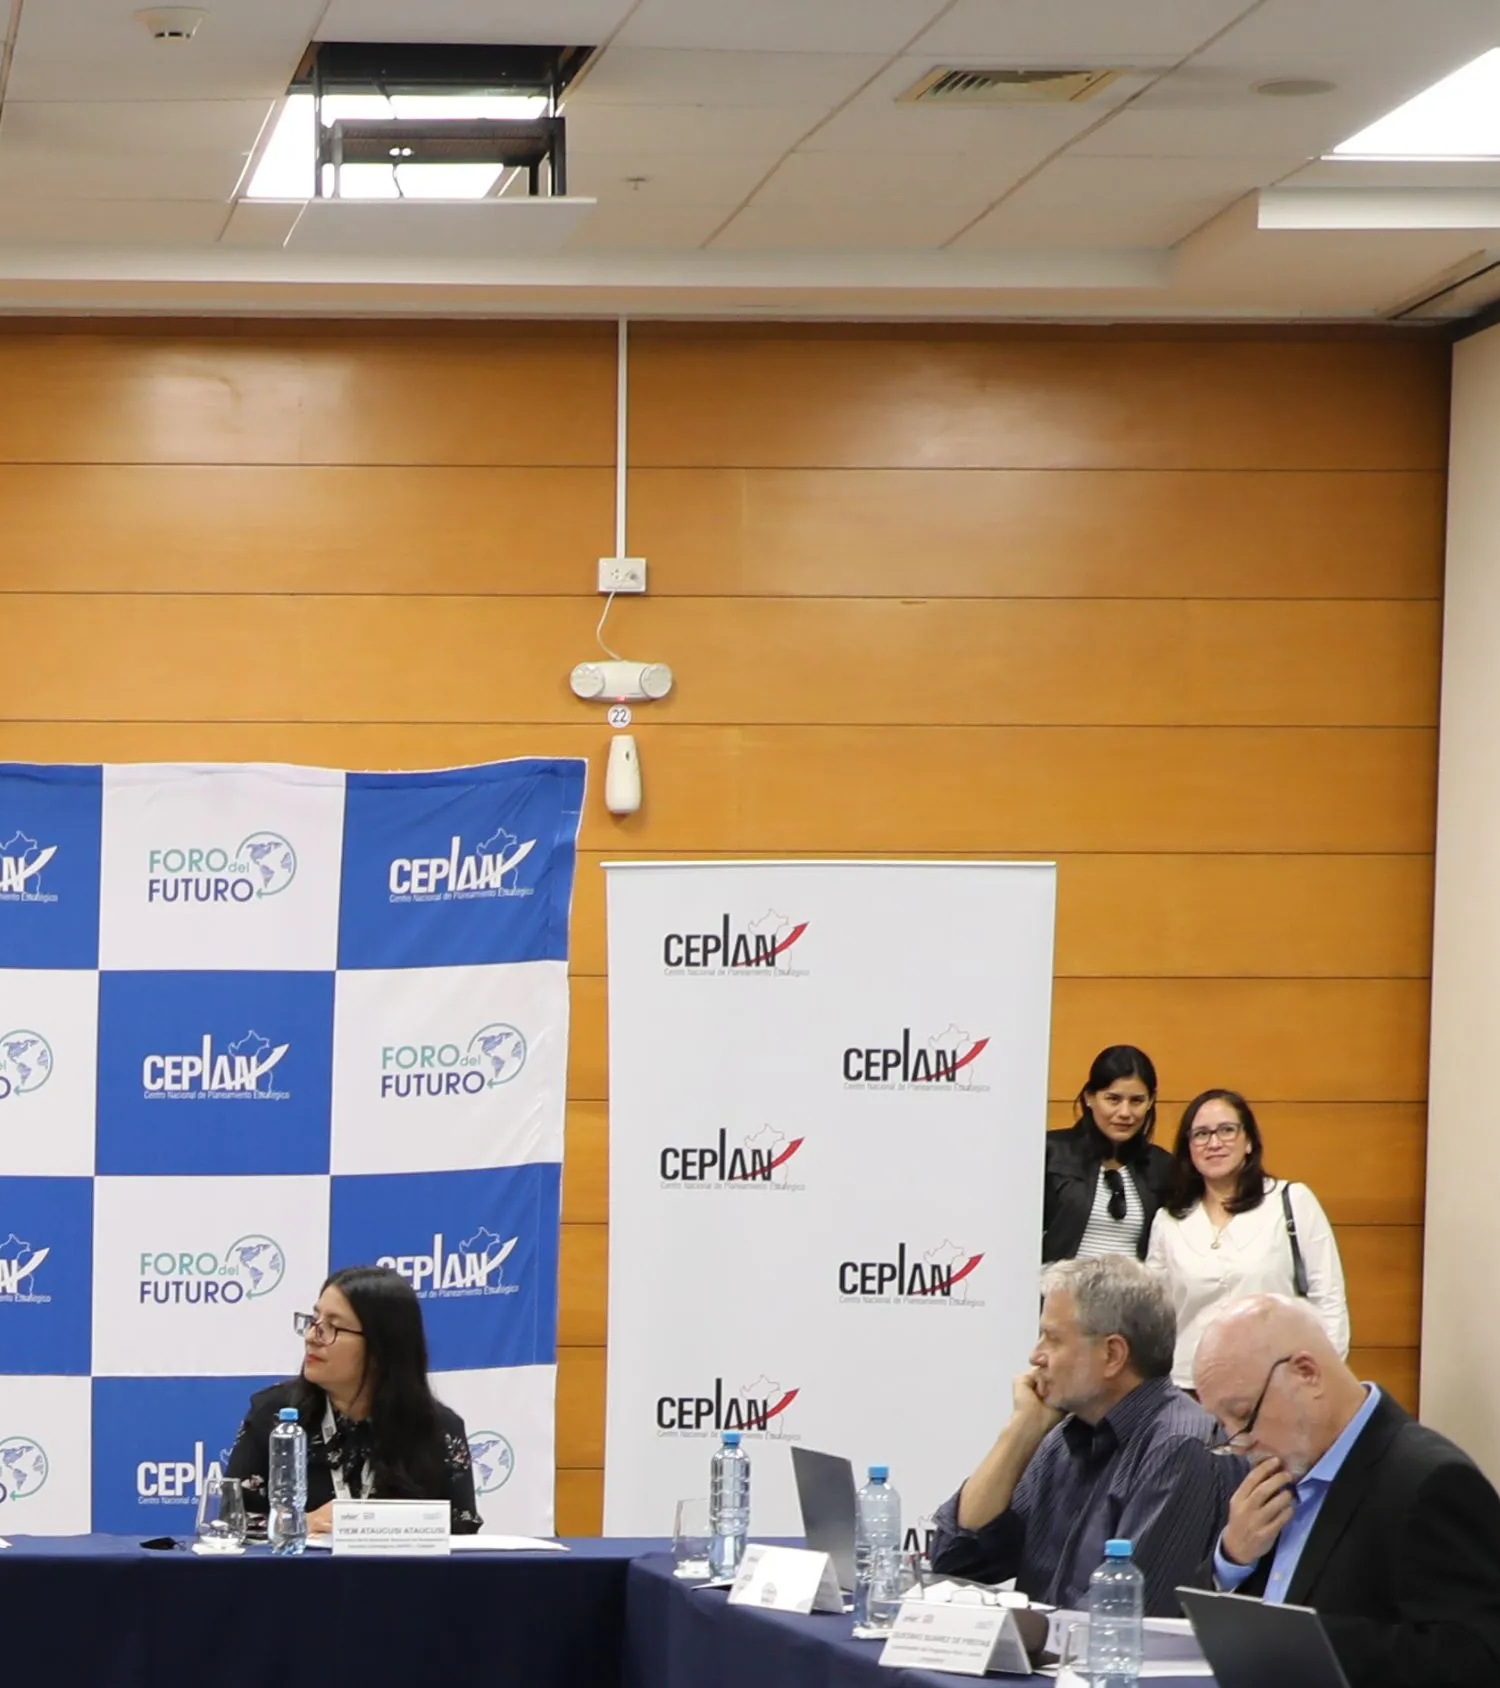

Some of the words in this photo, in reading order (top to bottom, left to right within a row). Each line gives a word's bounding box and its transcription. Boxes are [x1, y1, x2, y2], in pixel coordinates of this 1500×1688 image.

[612, 710, 627, 723] 22
[149, 848, 228, 874] FORO
[228, 861, 250, 873] del
[389, 836, 504, 894] CEPLAN
[148, 878, 253, 903] FUTURO
[663, 913, 777, 967] CEPLAN
[143, 1034, 257, 1091] CEPLAN
[381, 1043, 460, 1070] FORO
[459, 1055, 481, 1067] del
[843, 1028, 957, 1082] CEPLAN
[381, 1070, 485, 1098] FUTURO
[660, 1128, 772, 1181] CEPLAN
[140, 1252, 218, 1276] FORO
[217, 1264, 239, 1276] del
[839, 1242, 951, 1297] CEPLAN
[140, 1280, 243, 1304] FUTURO
[656, 1377, 769, 1431] CEPLAN
